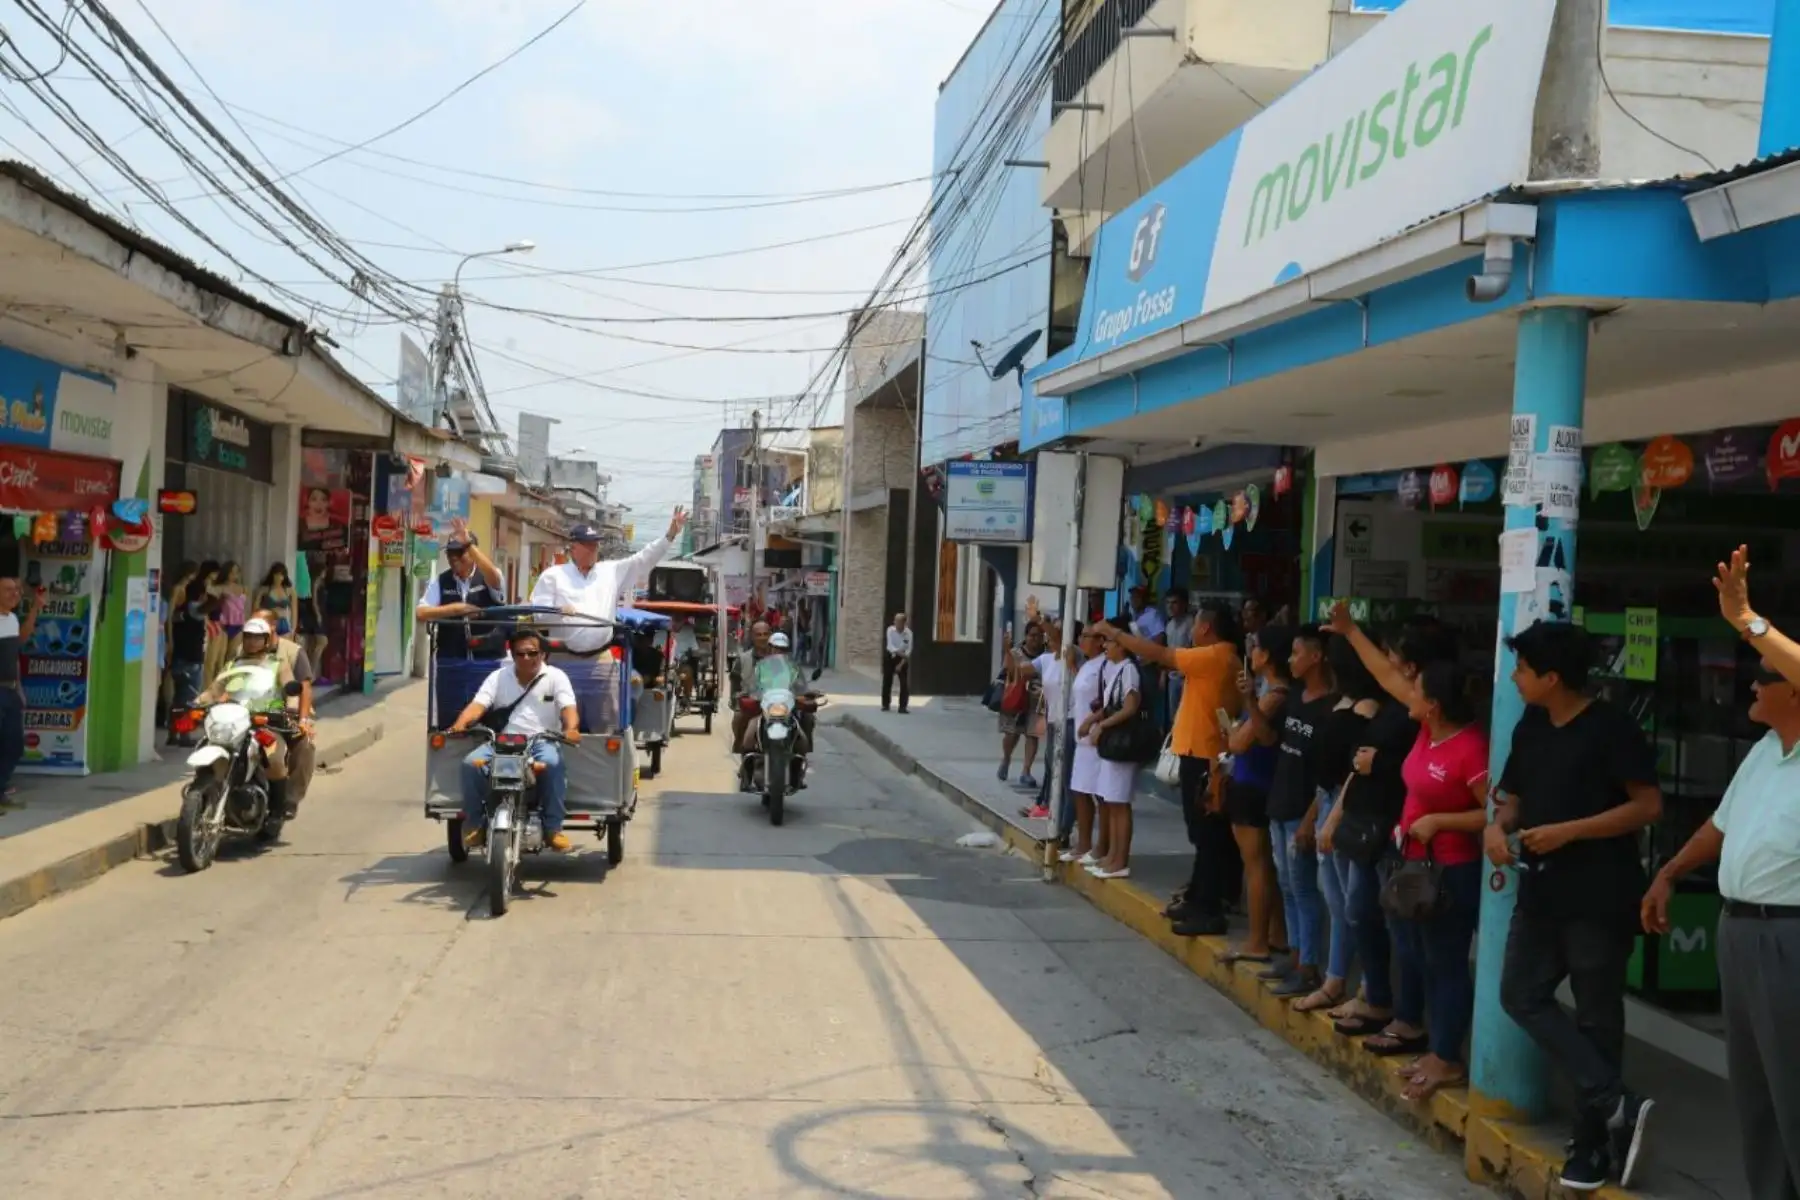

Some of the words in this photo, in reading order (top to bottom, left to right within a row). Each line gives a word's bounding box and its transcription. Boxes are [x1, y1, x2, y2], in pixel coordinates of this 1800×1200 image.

[1243, 23, 1494, 249] movistar
[1093, 304, 1133, 346] Grupo
[1133, 284, 1176, 327] Fossa
[60, 409, 113, 440] movistar
[23, 711, 72, 729] ECARGAS
